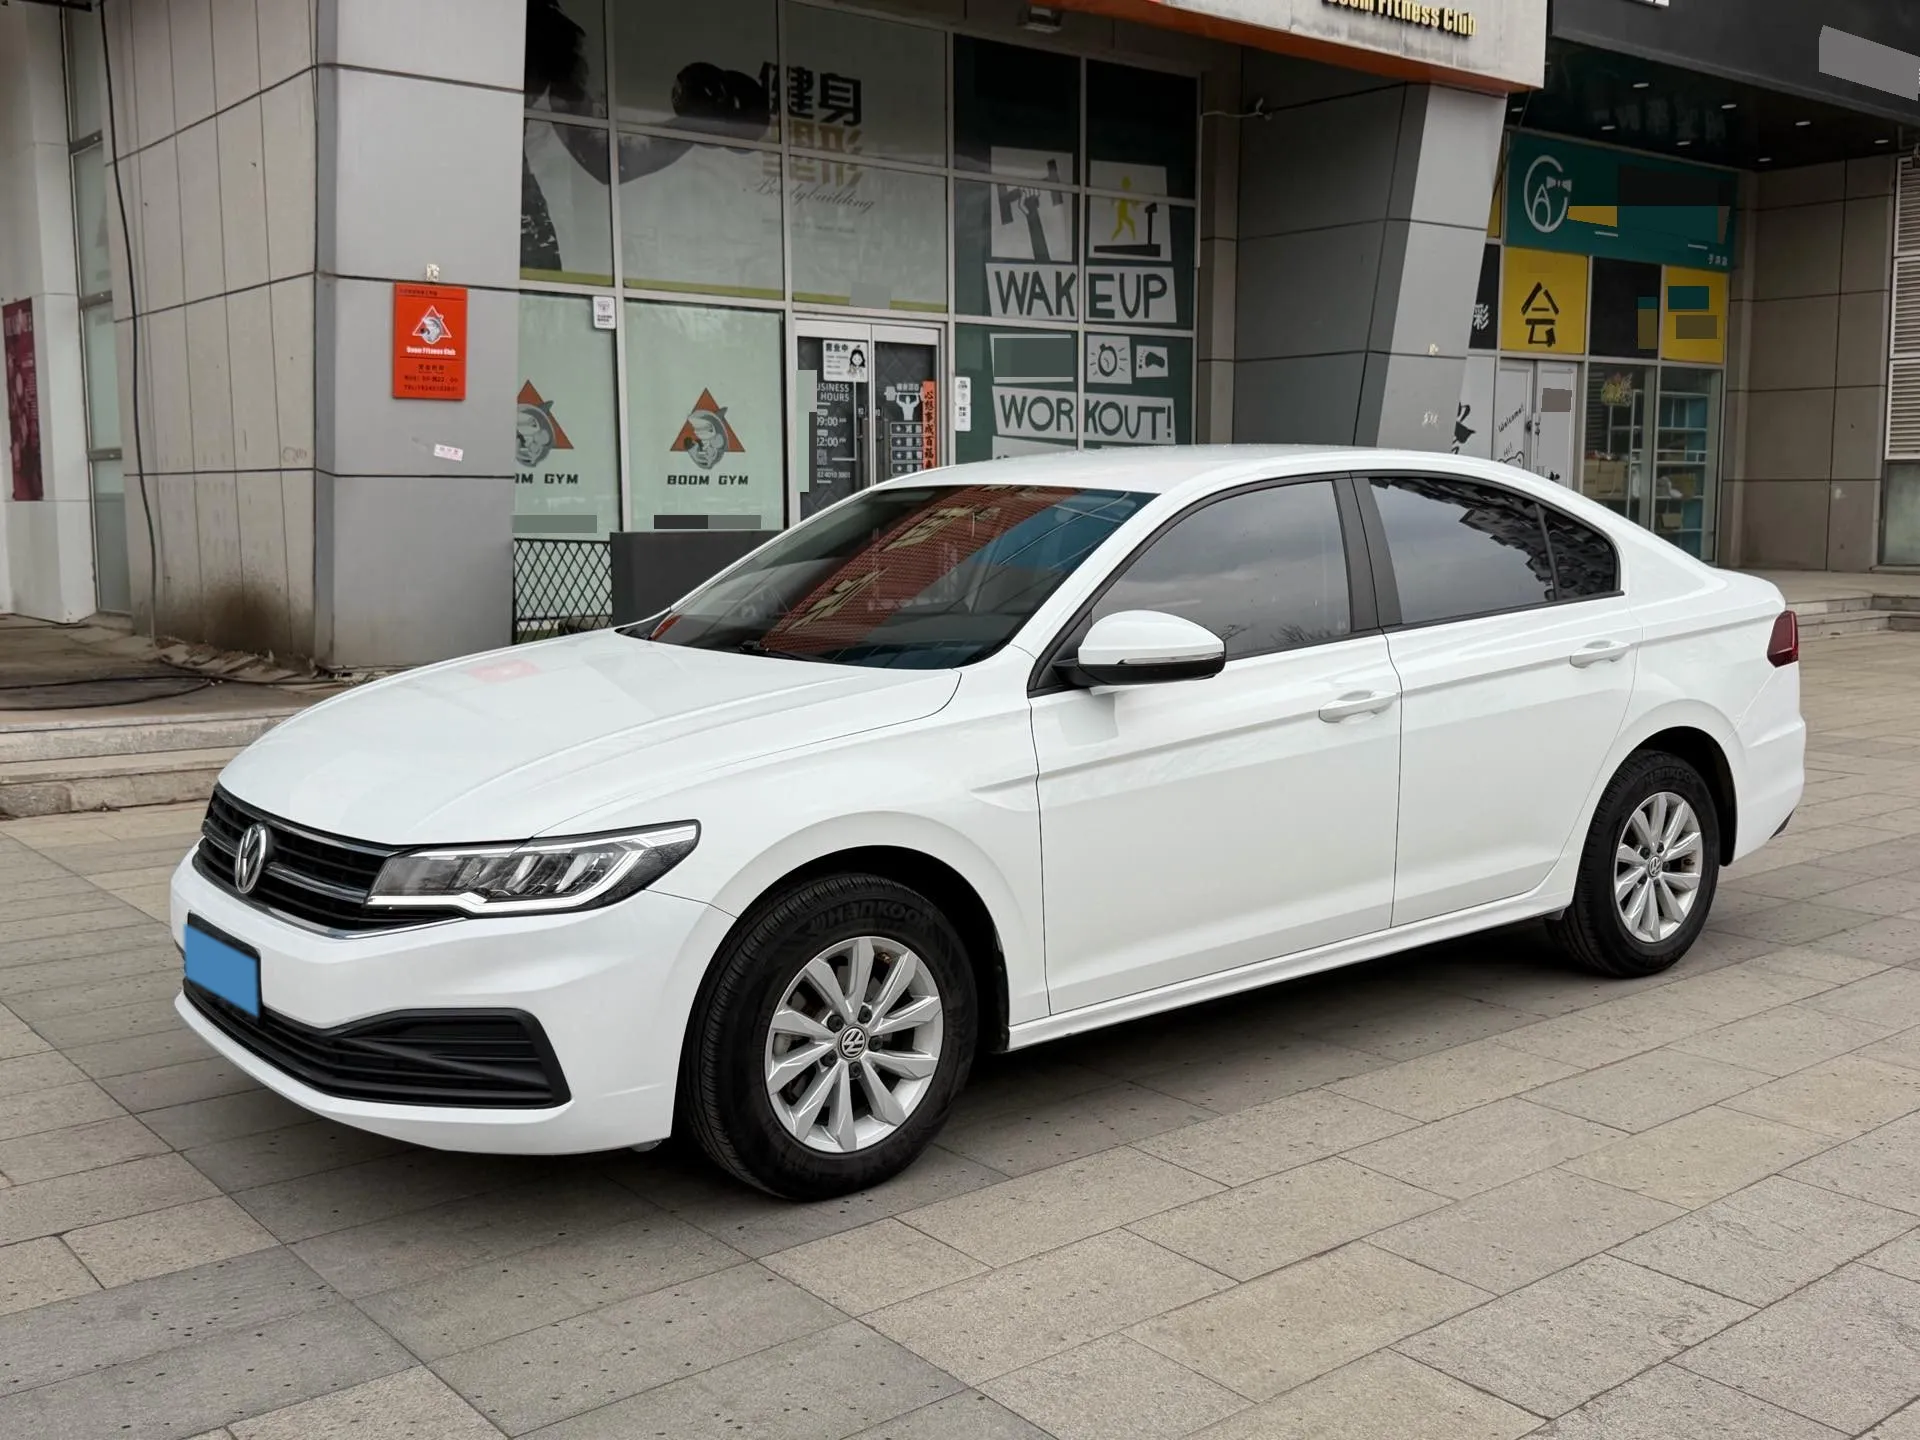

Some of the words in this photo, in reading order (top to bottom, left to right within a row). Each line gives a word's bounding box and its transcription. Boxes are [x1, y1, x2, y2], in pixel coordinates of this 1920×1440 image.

[1443, 7, 1477, 37] Club
[758, 61, 862, 127] 健身
[820, 392, 849, 402] HOURS
[544, 473, 578, 484] GYM
[667, 475, 709, 486] BOOM
[718, 475, 749, 486] GYM
